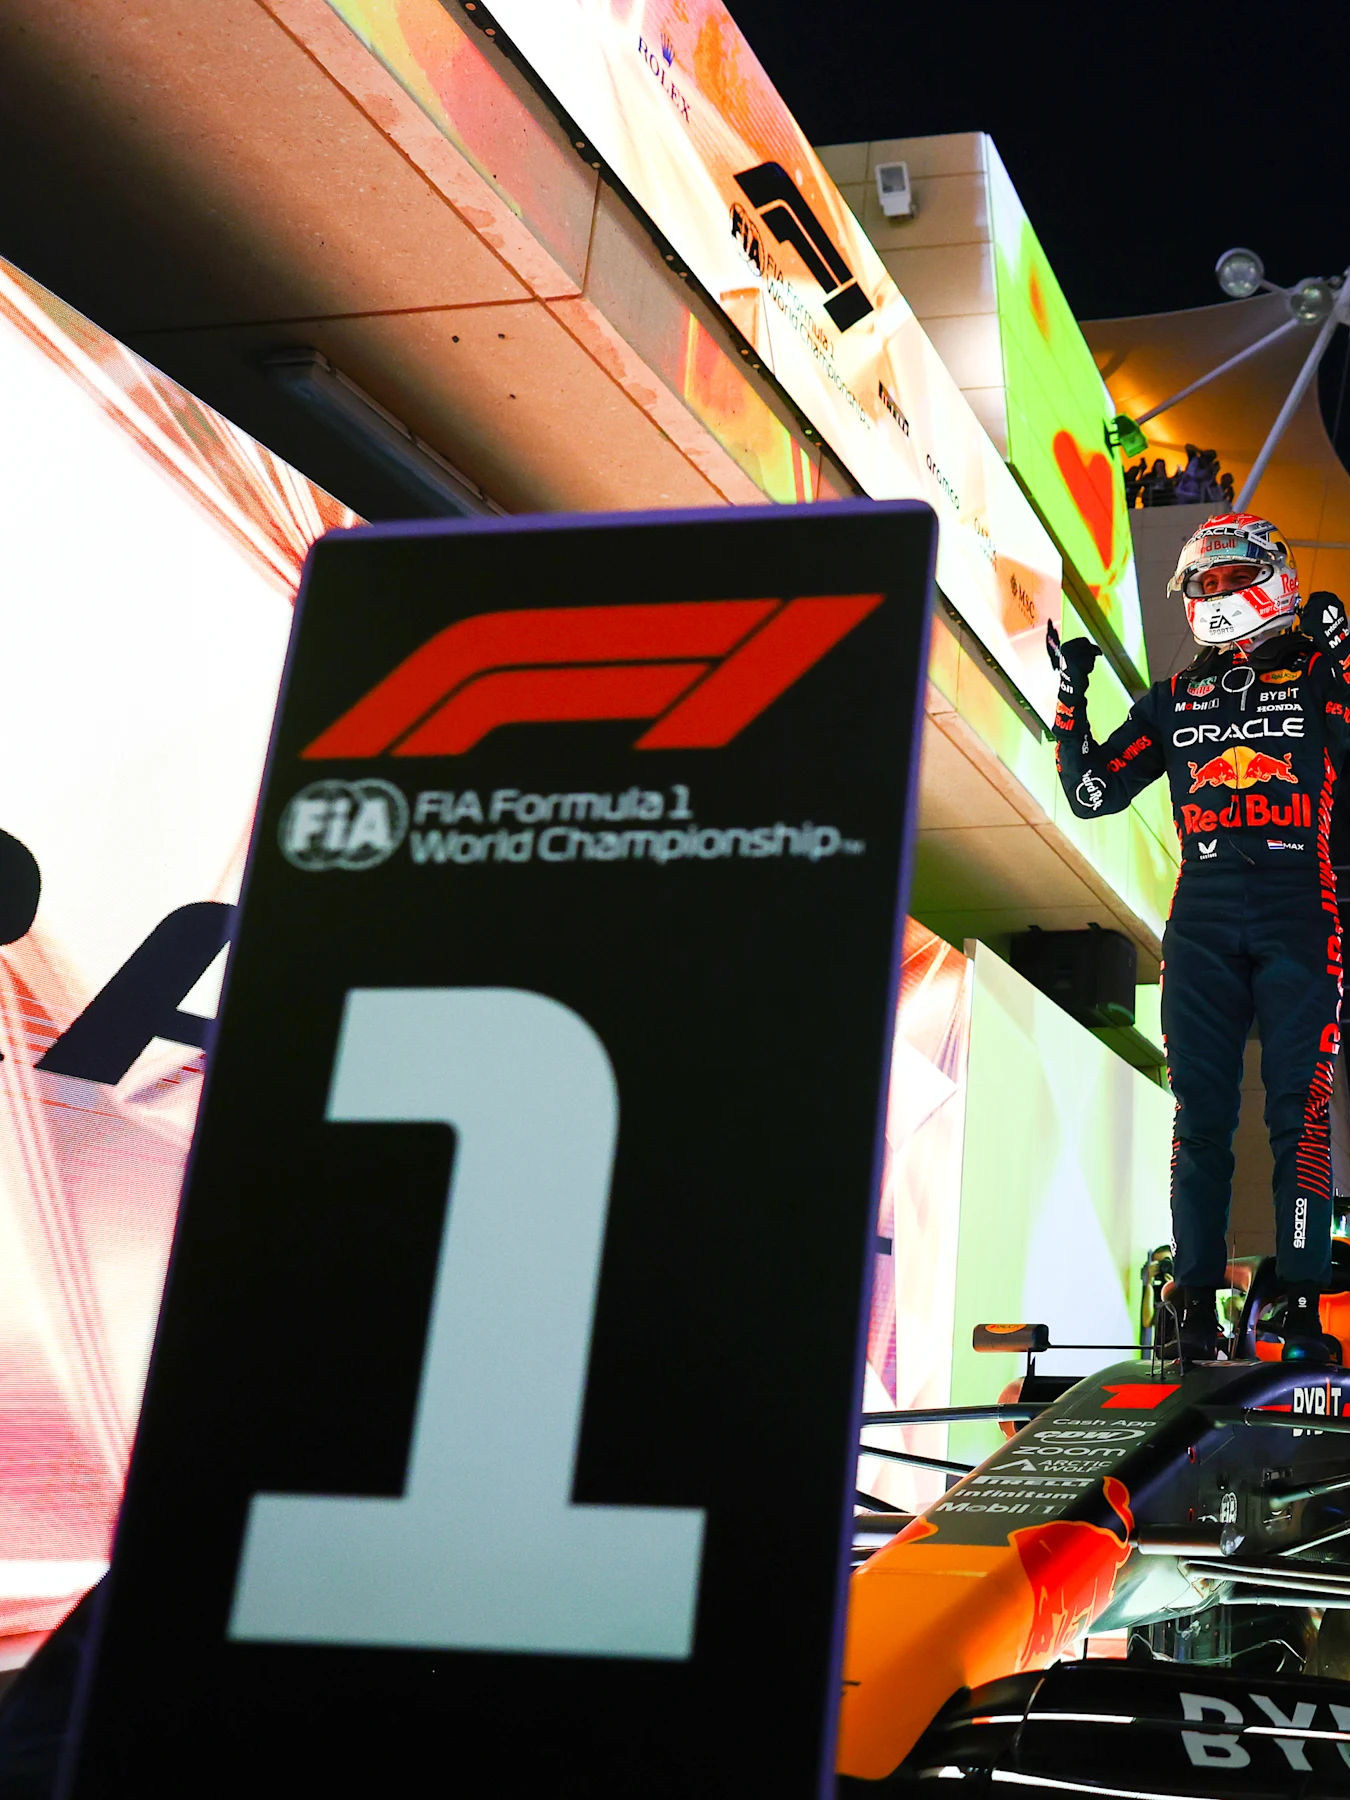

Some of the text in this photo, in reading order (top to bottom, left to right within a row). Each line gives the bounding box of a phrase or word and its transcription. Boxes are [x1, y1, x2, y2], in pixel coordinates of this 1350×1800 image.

[638, 35, 690, 124] ROLEX
[787, 281, 829, 352] Formula
[766, 272, 867, 423] World Championship
[926, 453, 960, 510] aramco
[1214, 538, 1236, 551] Bull
[1018, 583, 1035, 619] MSC
[1209, 615, 1232, 630] EA
[1209, 626, 1235, 636] SPORTS
[1259, 687, 1300, 702] BYBIT
[1174, 699, 1209, 713] Mobil
[1256, 702, 1304, 713] HONDA
[1172, 717, 1306, 748] ORACLE
[413, 789, 485, 824] FIA
[488, 785, 665, 824] Formula
[667, 783, 695, 820] 1
[1180, 793, 1312, 836] Red Bull
[409, 828, 536, 865] World
[1283, 842, 1305, 851] MAX
[1293, 1197, 1307, 1249] sparco
[228, 986, 707, 1661] 1
[1052, 1418, 1157, 1428] Cash App
[1038, 1459, 1113, 1468] ARCTIC
[1044, 1465, 1101, 1473] WOLF
[971, 1475, 1096, 1487] PIRELLI
[954, 1489, 1079, 1500] infinitum
[934, 1501, 1032, 1514] Mobil
